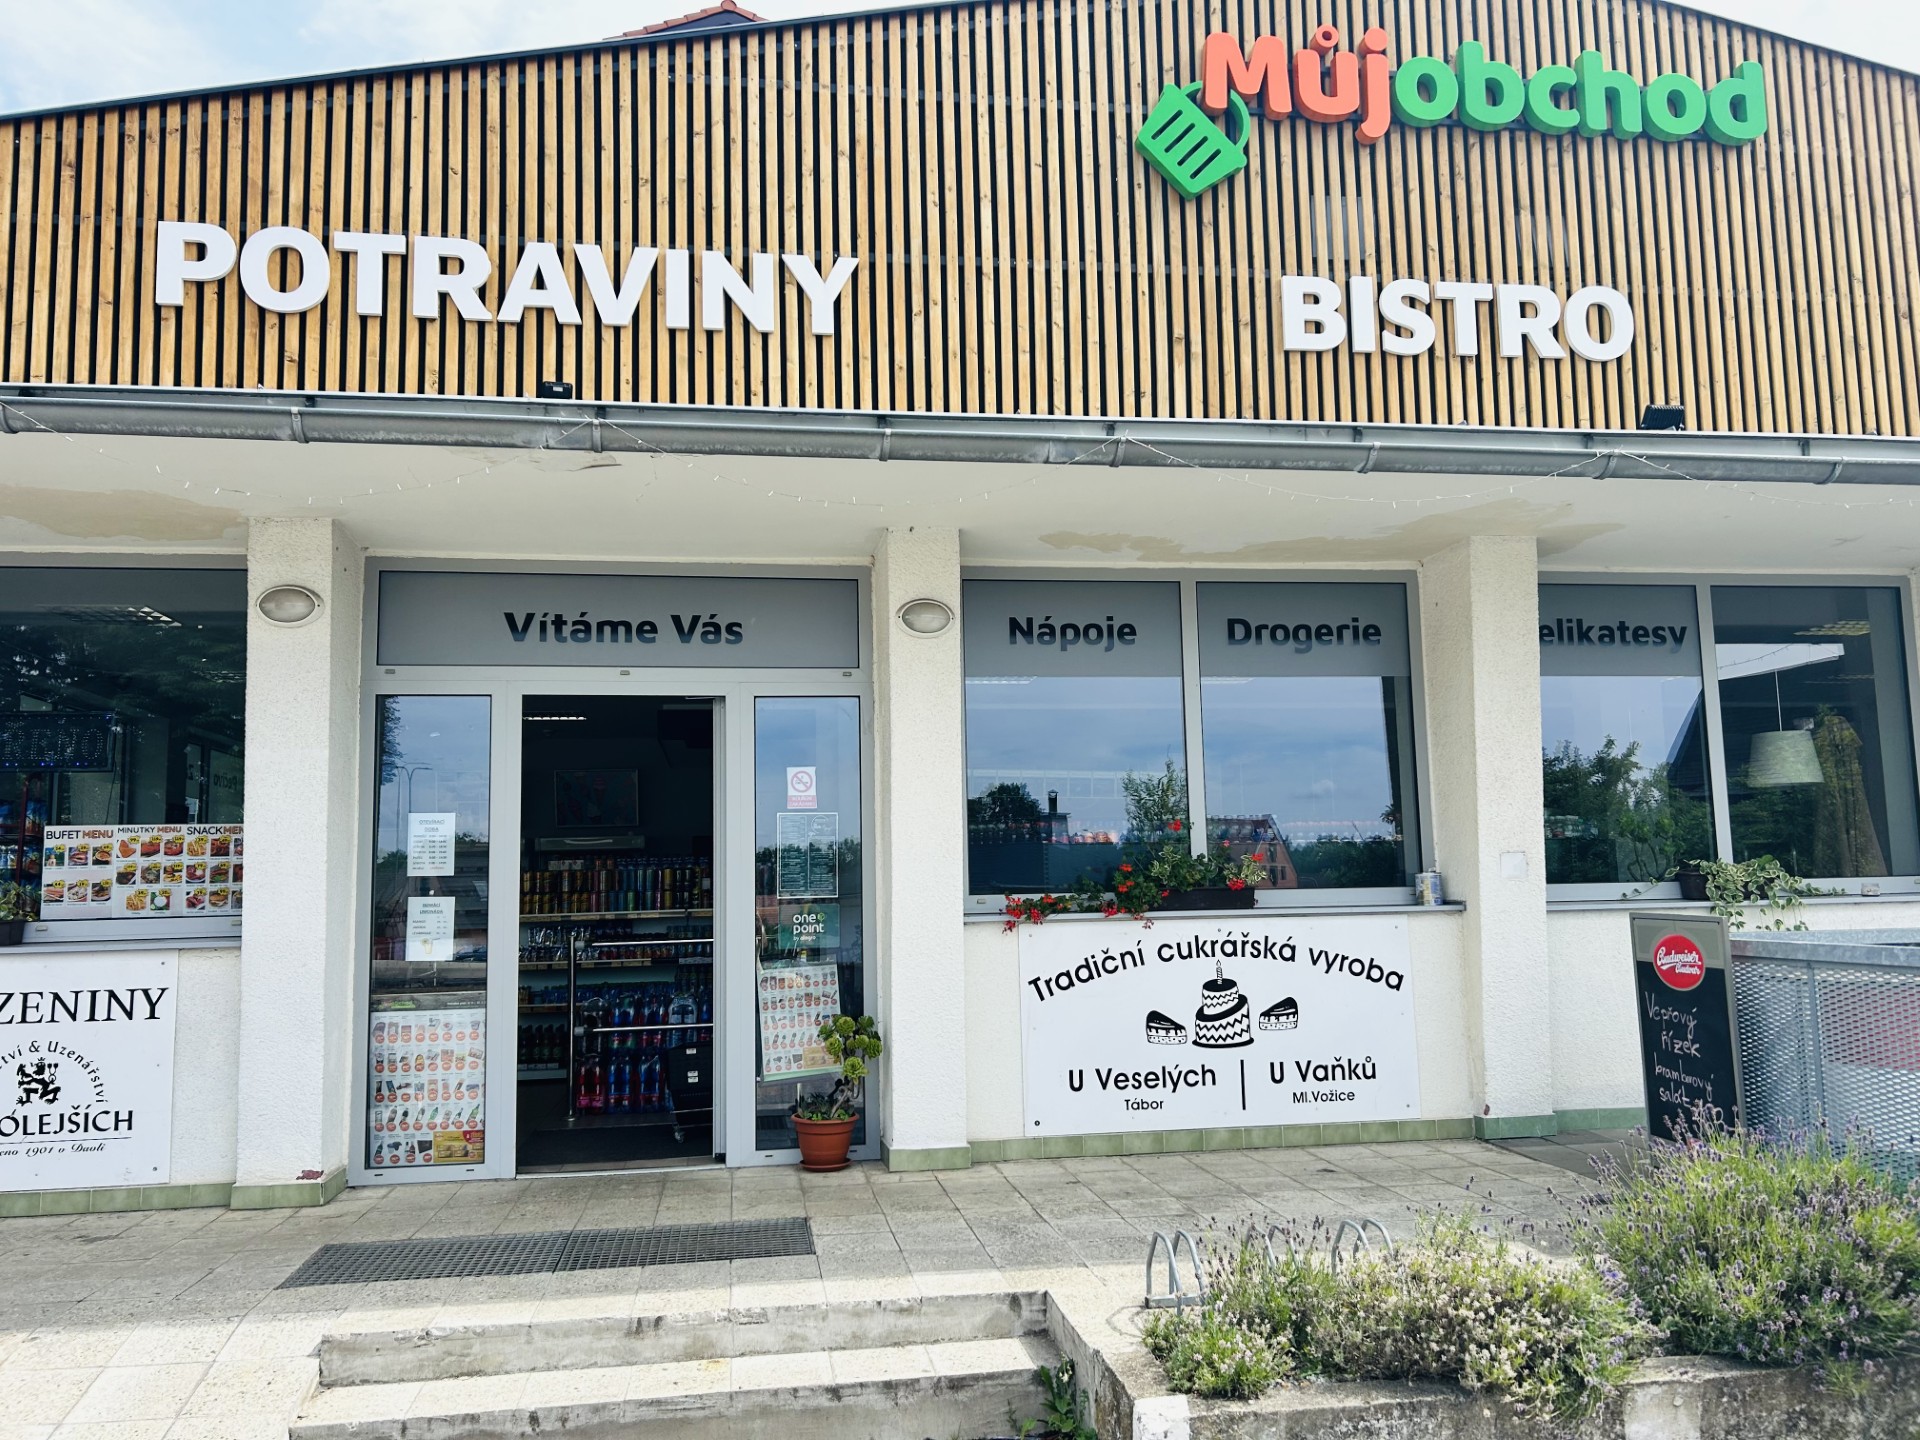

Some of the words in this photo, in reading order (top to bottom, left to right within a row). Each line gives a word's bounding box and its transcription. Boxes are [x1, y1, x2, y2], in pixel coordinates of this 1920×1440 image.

[155, 220, 859, 336] POTRAVINY
[1280, 274, 1635, 362] BISTRO
[504, 611, 658, 644] Vítáme
[669, 612, 744, 645] Vás
[1009, 615, 1138, 651] Nápoje
[1227, 616, 1382, 655] Drogerie
[45, 830, 81, 840] BUFET
[82, 829, 114, 839] MENU
[117, 826, 156, 834] MINUTKY
[157, 826, 182, 834] MENU
[186, 825, 223, 835] SNACK
[793, 914, 816, 923] one
[793, 923, 825, 935] point
[1028, 940, 1146, 1002] Tradiční
[1157, 931, 1297, 963] cukrářská
[1308, 947, 1405, 992] vyroba
[0, 987, 170, 1025] ZENINY
[1644, 991, 1698, 1037] Vepřový
[1661, 1030, 1701, 1058] řízek
[0, 1045, 22, 1069] tví
[28, 1040, 40, 1053] &
[47, 1040, 108, 1103] Uzenářství
[1068, 1069, 1084, 1092] U
[1095, 1064, 1217, 1093] Veselých
[1269, 1061, 1285, 1085] U
[1295, 1056, 1378, 1083] Vaňků
[1124, 1097, 1164, 1111] Tábor
[1659, 1081, 1692, 1108] salát
[25, 1146, 54, 1158] 1901
